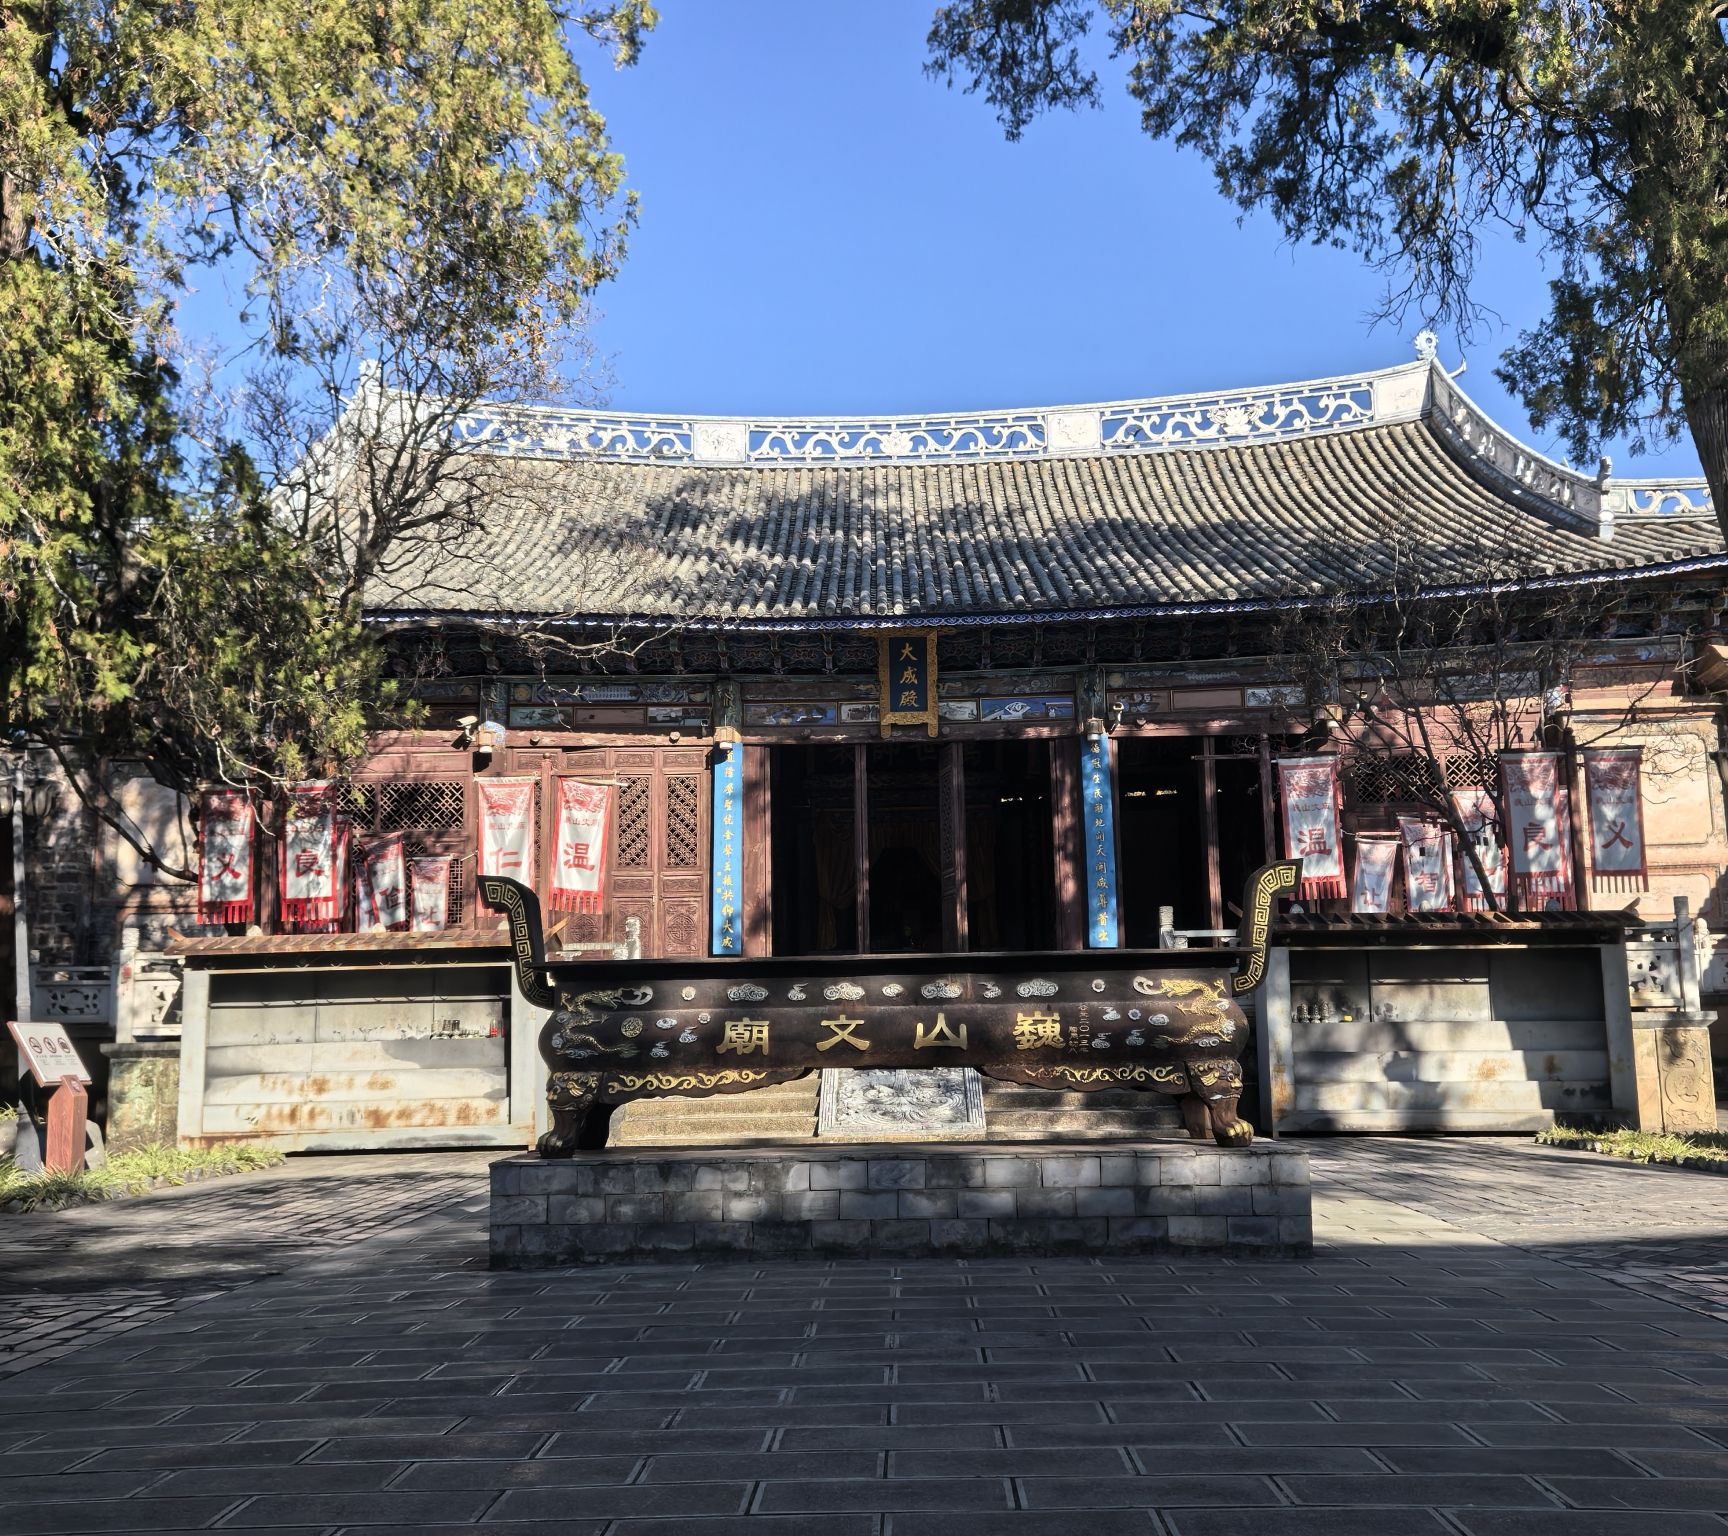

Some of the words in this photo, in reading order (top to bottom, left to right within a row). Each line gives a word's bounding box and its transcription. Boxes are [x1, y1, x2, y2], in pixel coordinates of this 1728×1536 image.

[899, 642, 919, 708] 大成殿
[1297, 827, 1332, 856] 温
[1523, 822, 1553, 851] 良
[1602, 820, 1634, 849] 义
[211, 853, 241, 880] 义
[296, 848, 324, 877] 良
[490, 847, 522, 875] 仁
[563, 842, 595, 872] 温
